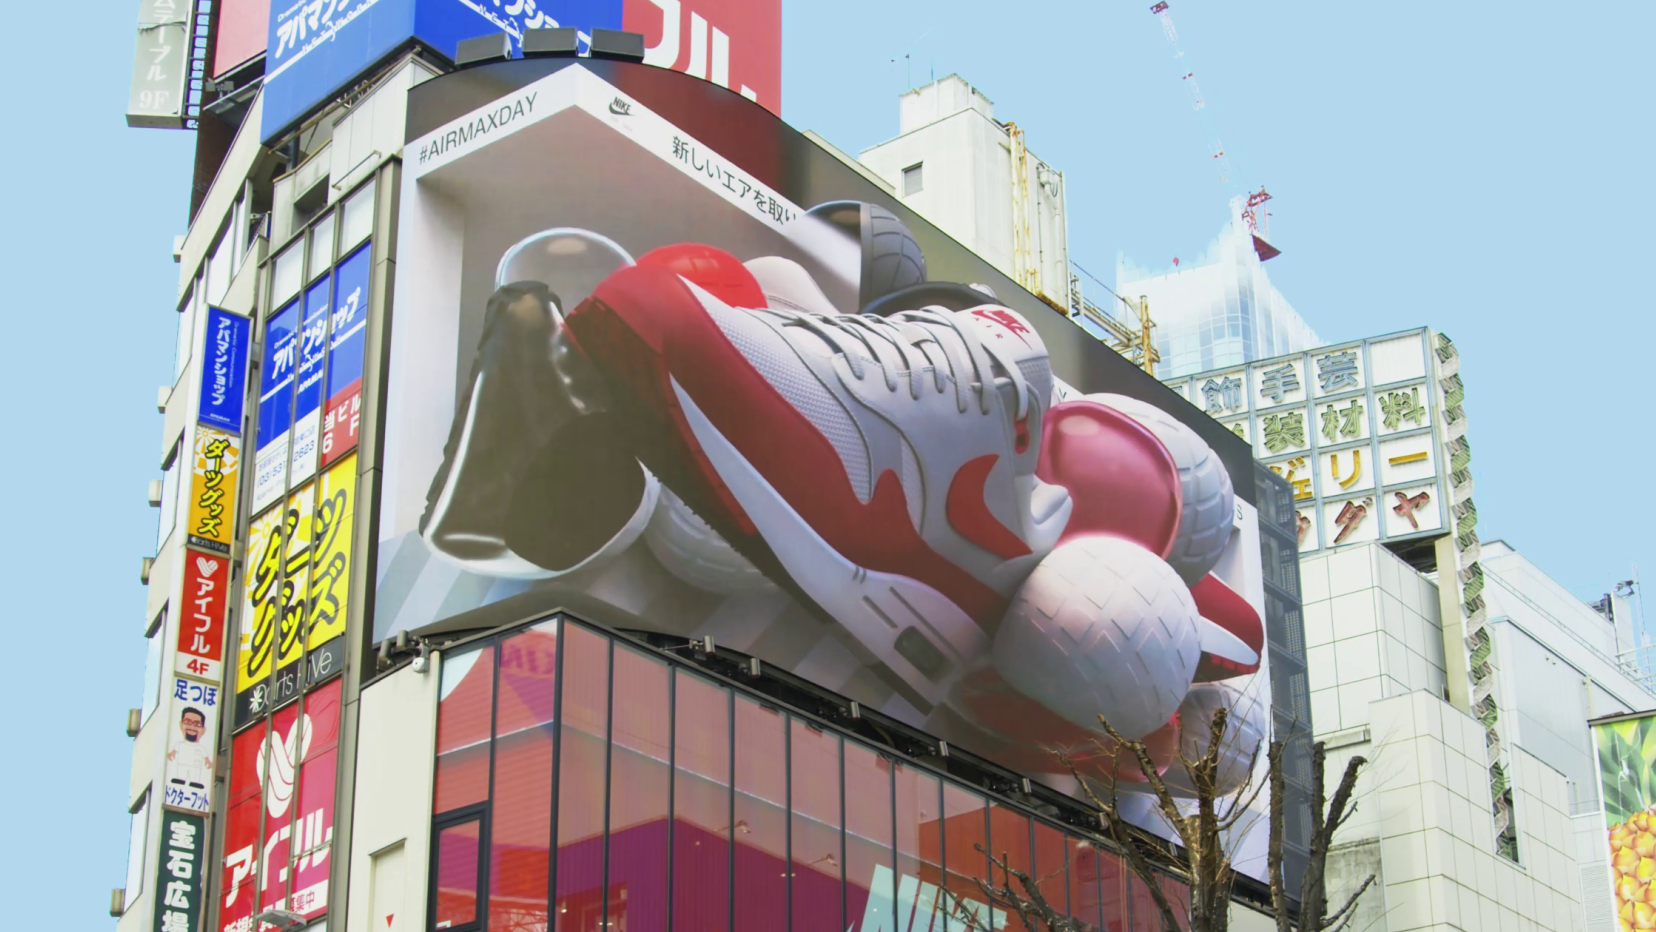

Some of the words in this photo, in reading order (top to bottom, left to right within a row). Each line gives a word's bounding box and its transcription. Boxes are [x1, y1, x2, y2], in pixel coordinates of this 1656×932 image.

[140, 89, 169, 109] 9F
[419, 91, 538, 165] #AIRMAXDAY
[612, 96, 632, 114] NIKE
[212, 316, 232, 405] アパマンショップ
[1171, 351, 1358, 414] 飾手芸
[1232, 387, 1426, 453] 装材料
[198, 439, 230, 538] ダーツグッズ
[190, 577, 214, 654] アイフル
[174, 678, 218, 706] 足つぼ
[187, 658, 209, 675] 4F
